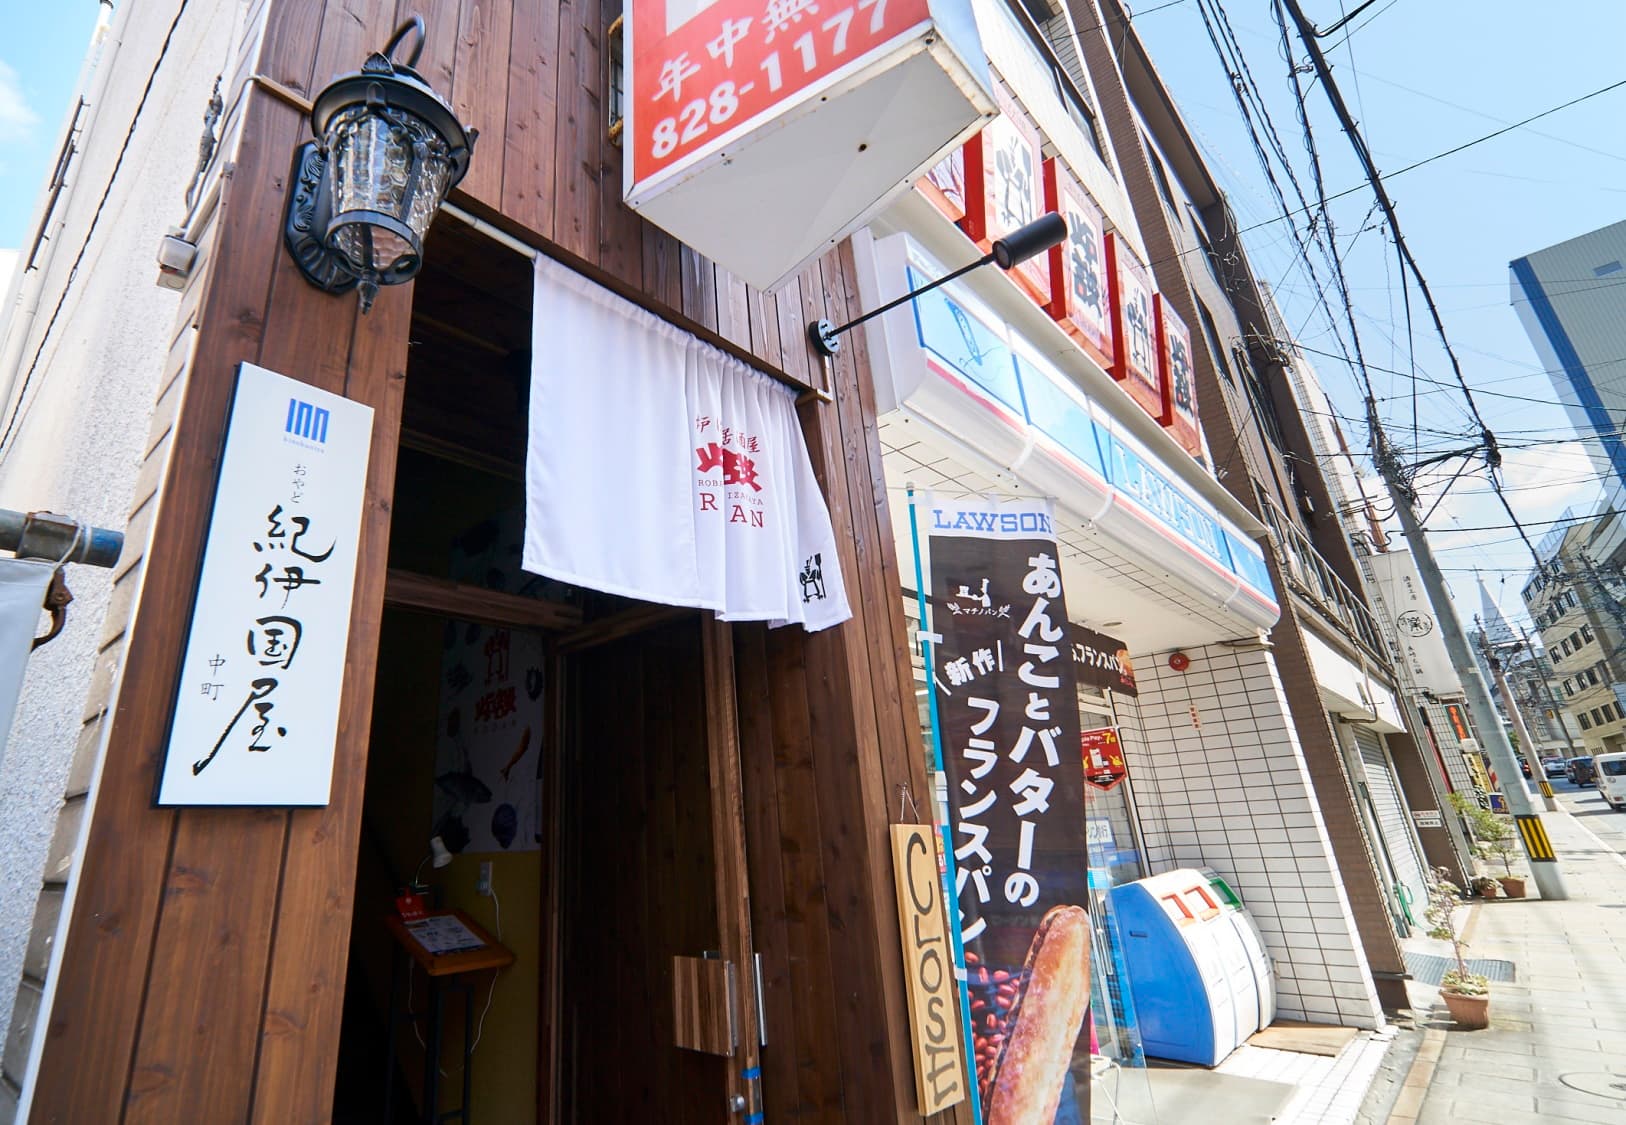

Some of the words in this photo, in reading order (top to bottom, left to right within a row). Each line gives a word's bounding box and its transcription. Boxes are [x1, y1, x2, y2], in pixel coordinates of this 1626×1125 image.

[652, 0, 888, 158] 828-1177
[290, 463, 306, 503] おやど
[933, 509, 1053, 533] LAWSON
[192, 504, 337, 776] 紀伊国屋
[201, 653, 226, 701] 中町
[944, 647, 996, 686] 新作
[1003, 553, 1064, 907] あんことバターの
[954, 696, 1000, 944] フランスパン
